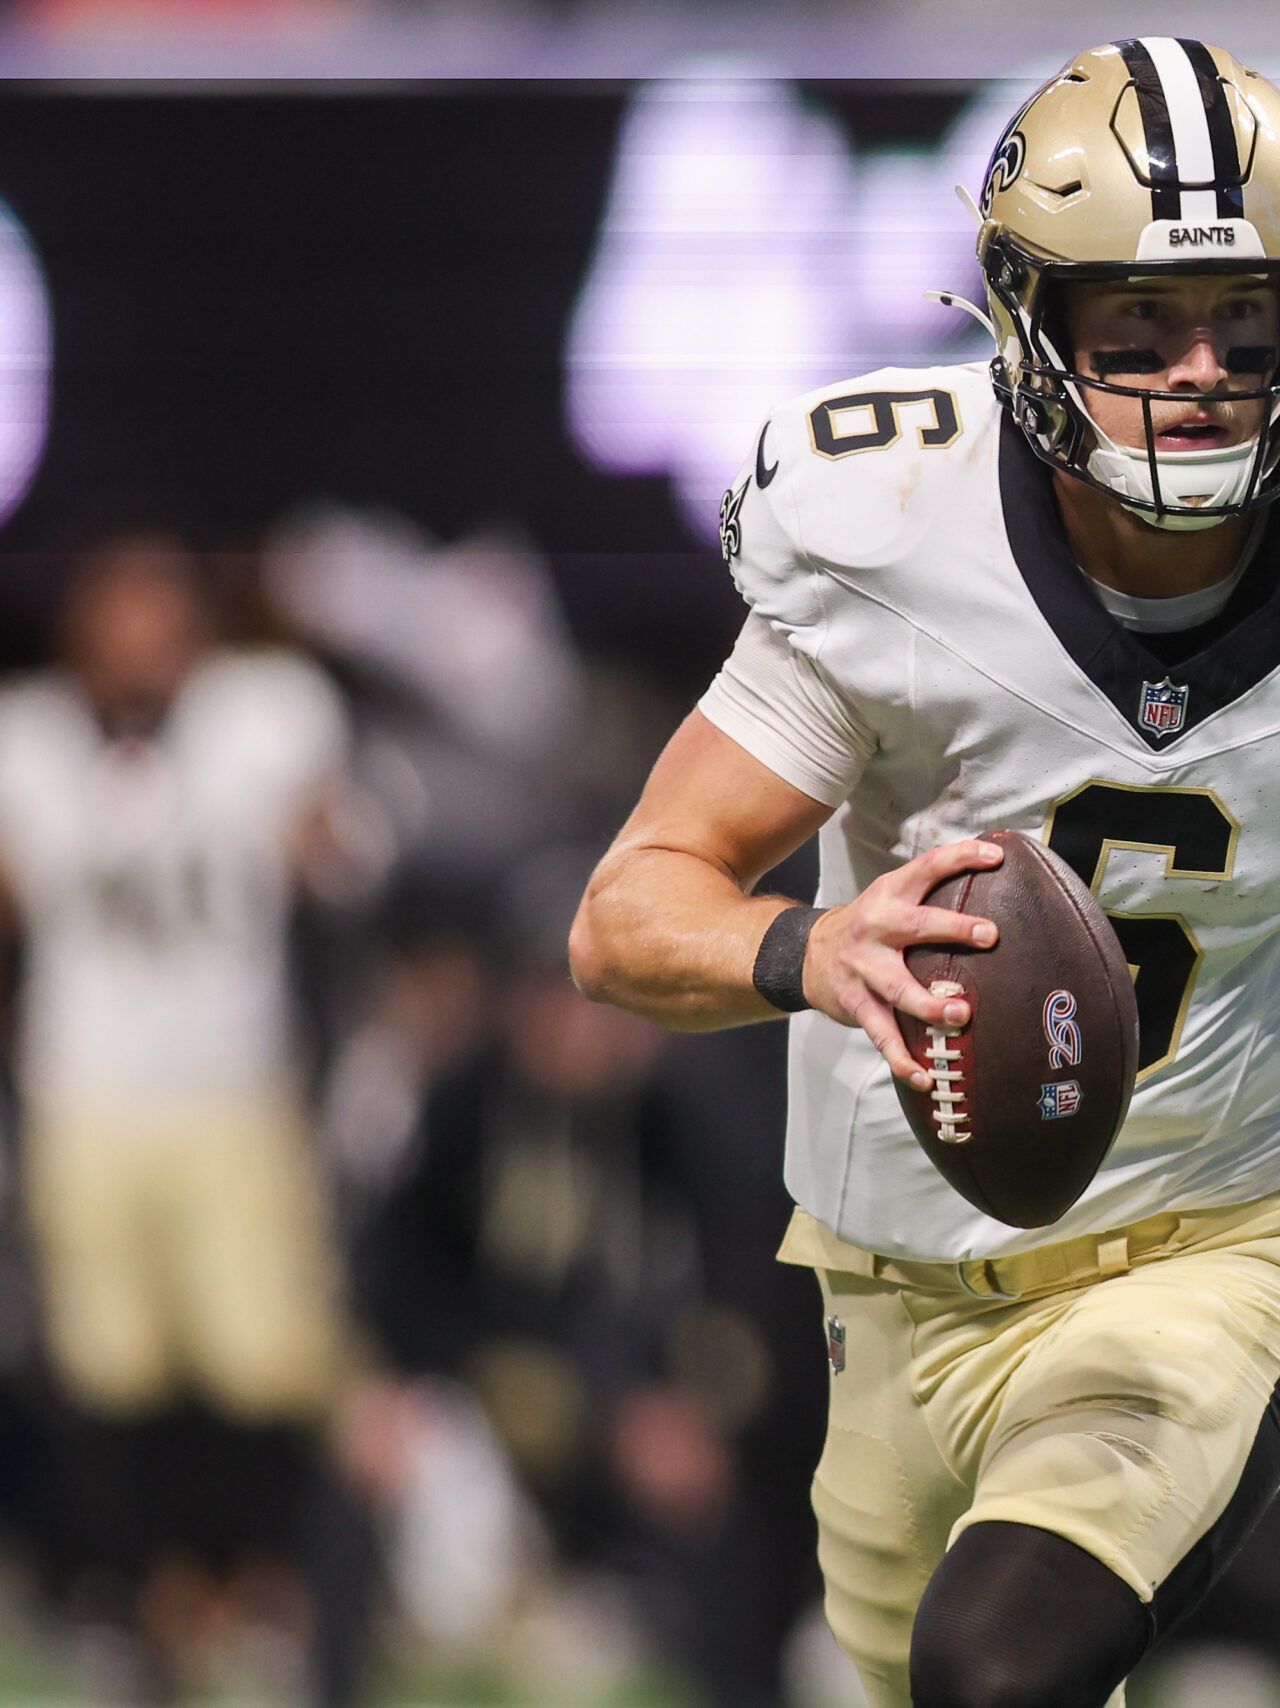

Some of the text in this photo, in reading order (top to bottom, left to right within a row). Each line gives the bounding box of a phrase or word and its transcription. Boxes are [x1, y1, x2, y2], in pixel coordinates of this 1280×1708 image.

[1168, 227, 1235, 246] SAINTS
[805, 388, 964, 462] 6
[1147, 703, 1179, 728] NFL
[1042, 778, 1241, 1086] 6
[1057, 1084, 1077, 1114] NFL
